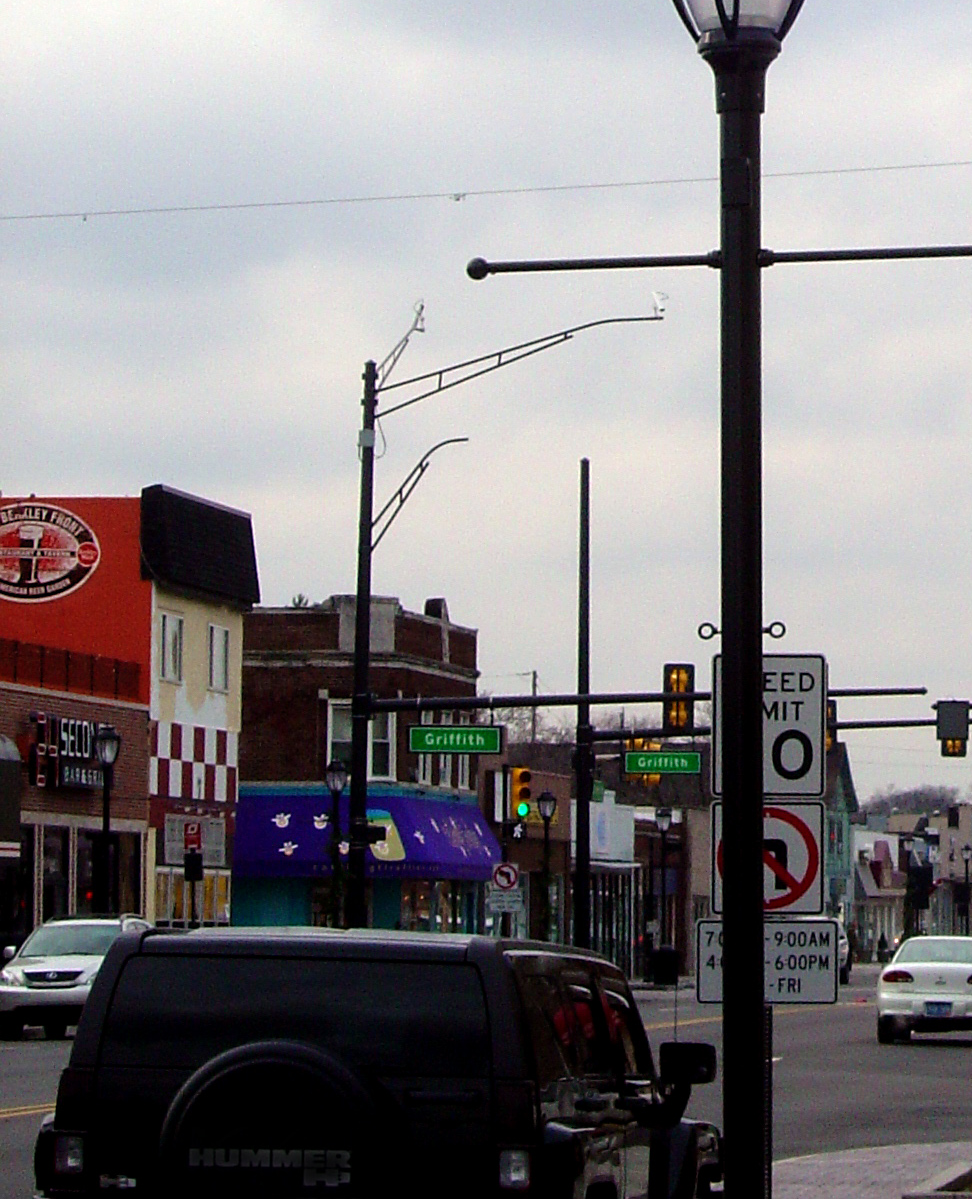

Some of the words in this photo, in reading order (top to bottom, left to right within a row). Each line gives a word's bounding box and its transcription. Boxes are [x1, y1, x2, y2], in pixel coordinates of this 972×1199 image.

[763, 672, 815, 692] EED
[763, 701, 804, 721] MIT
[425, 733, 485, 746] Griffith
[637, 756, 688, 768] Griffith
[772, 729, 813, 780] 0
[778, 978, 801, 993] FRI
[189, 1148, 351, 1168] HUMMER
